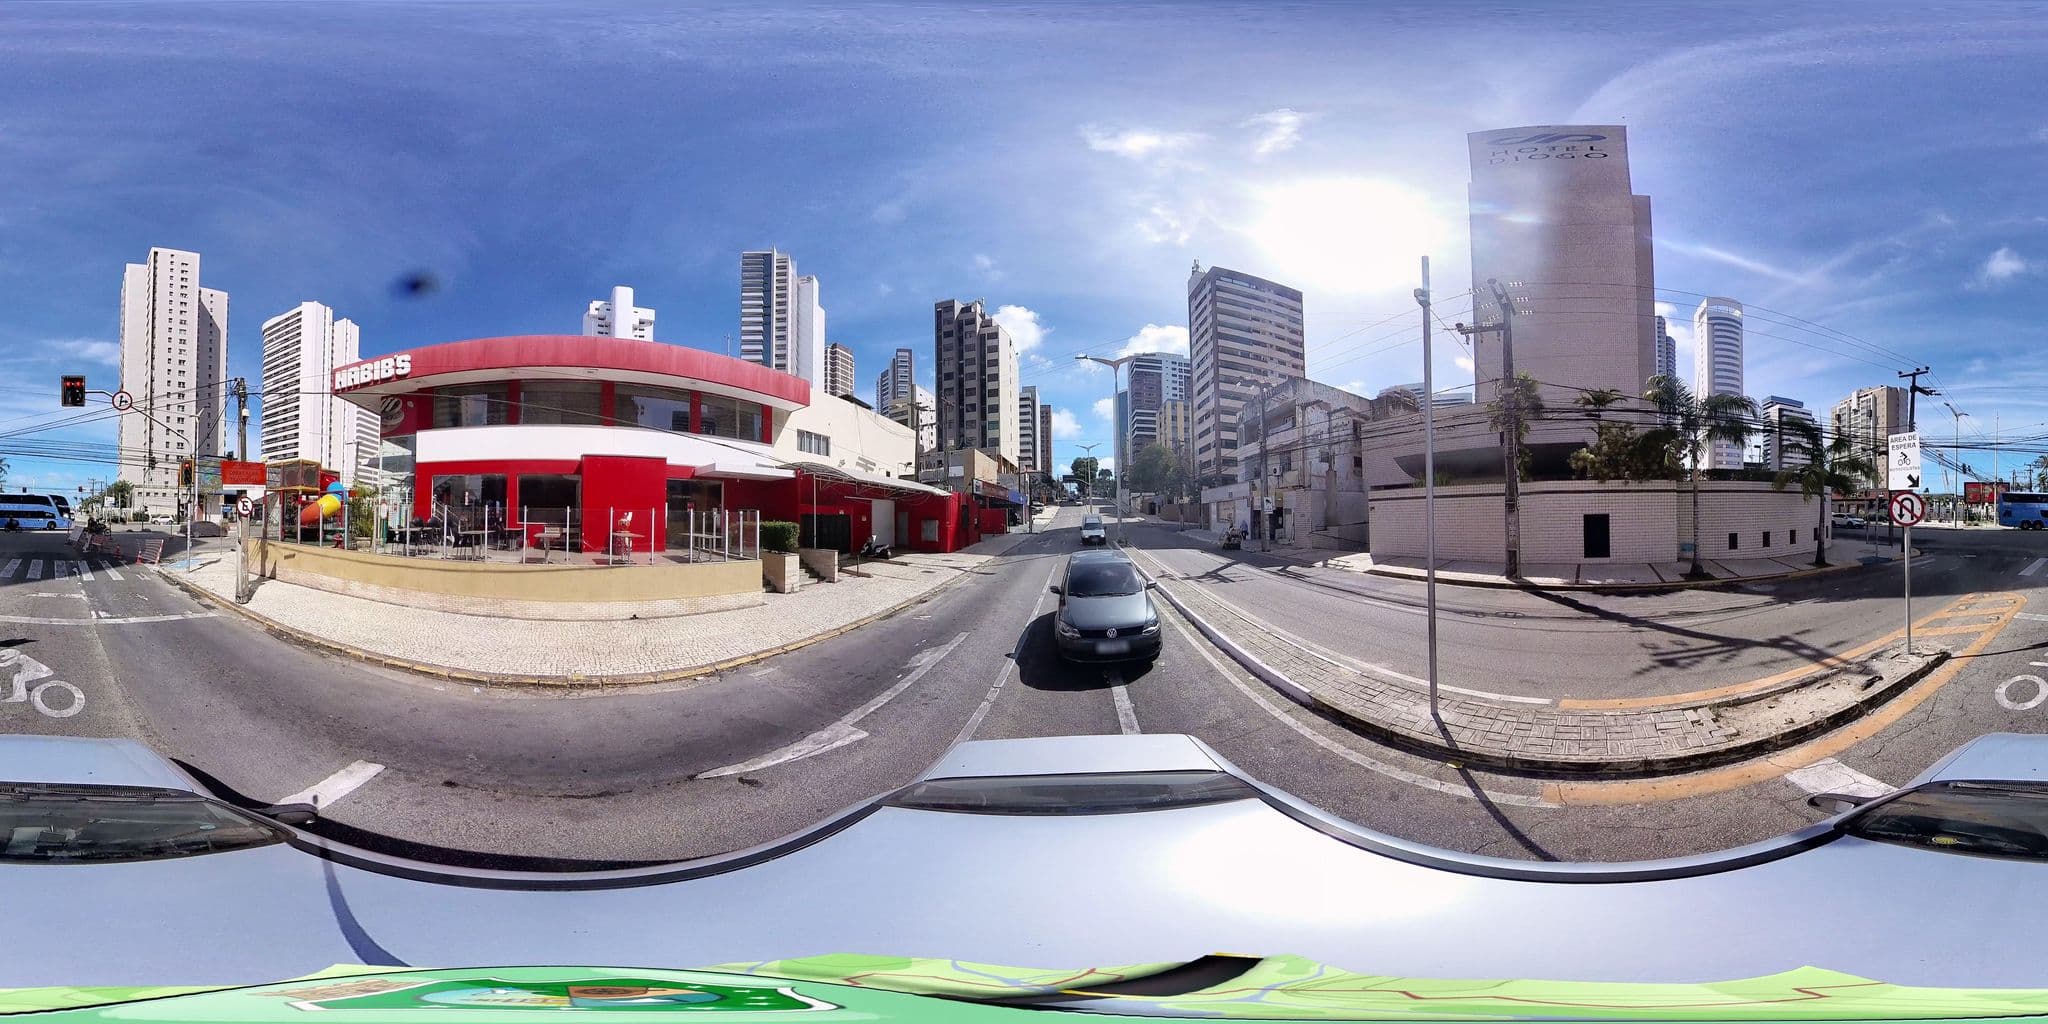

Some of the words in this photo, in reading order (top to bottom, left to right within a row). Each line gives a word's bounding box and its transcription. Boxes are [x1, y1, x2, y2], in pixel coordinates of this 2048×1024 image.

[1491, 145, 1602, 156] HOTEL
[1491, 153, 1608, 165] DIOGO
[335, 354, 411, 390] HABIB'S
[1891, 442, 1915, 451] ESPERA
